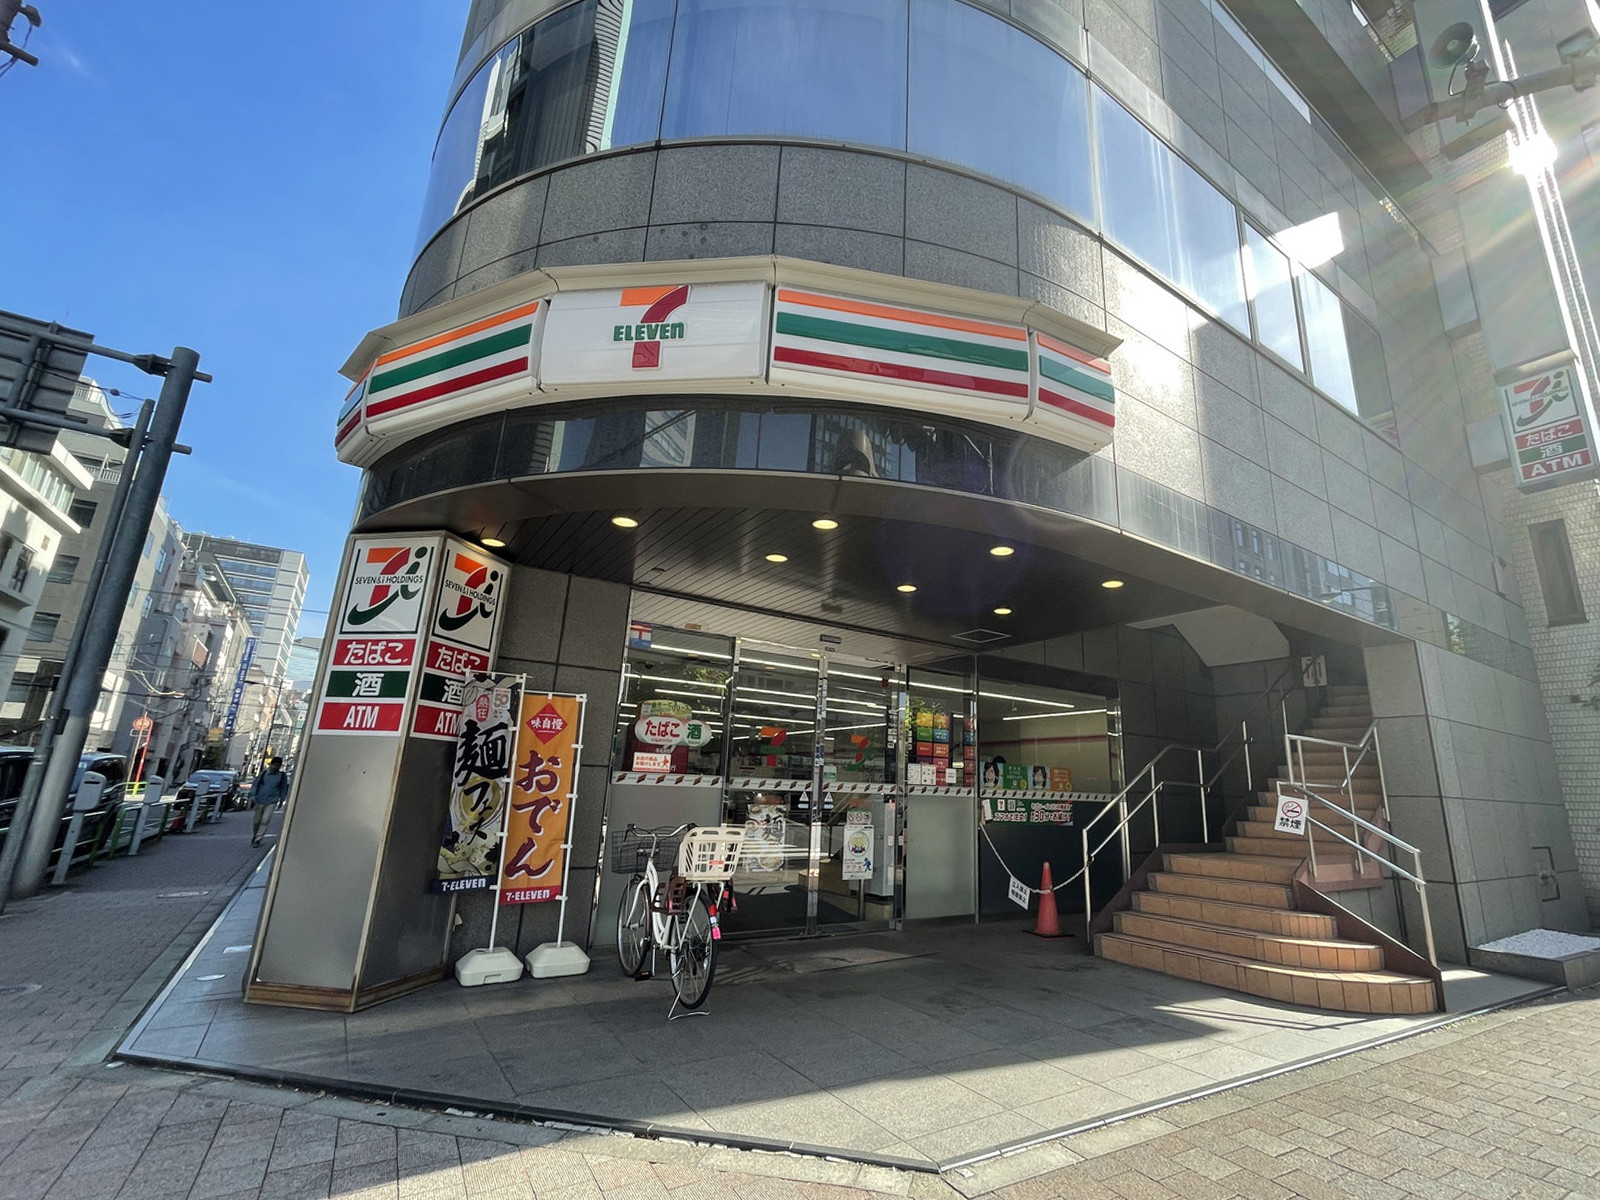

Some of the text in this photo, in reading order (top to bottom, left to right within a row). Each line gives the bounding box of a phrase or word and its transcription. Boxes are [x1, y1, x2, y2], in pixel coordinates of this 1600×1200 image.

[613, 322, 685, 341] ELEVEN
[1525, 423, 1573, 447] たばこ
[1540, 442, 1563, 459] 酒
[1531, 453, 1583, 477] ATM
[343, 641, 404, 665] たばこ
[352, 672, 385, 697] 酒
[441, 679, 464, 704] 酒
[343, 706, 380, 729] ATM
[530, 717, 563, 730] 味自慢
[645, 720, 681, 738] たばこ
[686, 723, 703, 740] 酒
[504, 750, 562, 881] おでん
[441, 877, 486, 892] 7-ELEVEN
[505, 889, 550, 902] 7-ELEVEN
